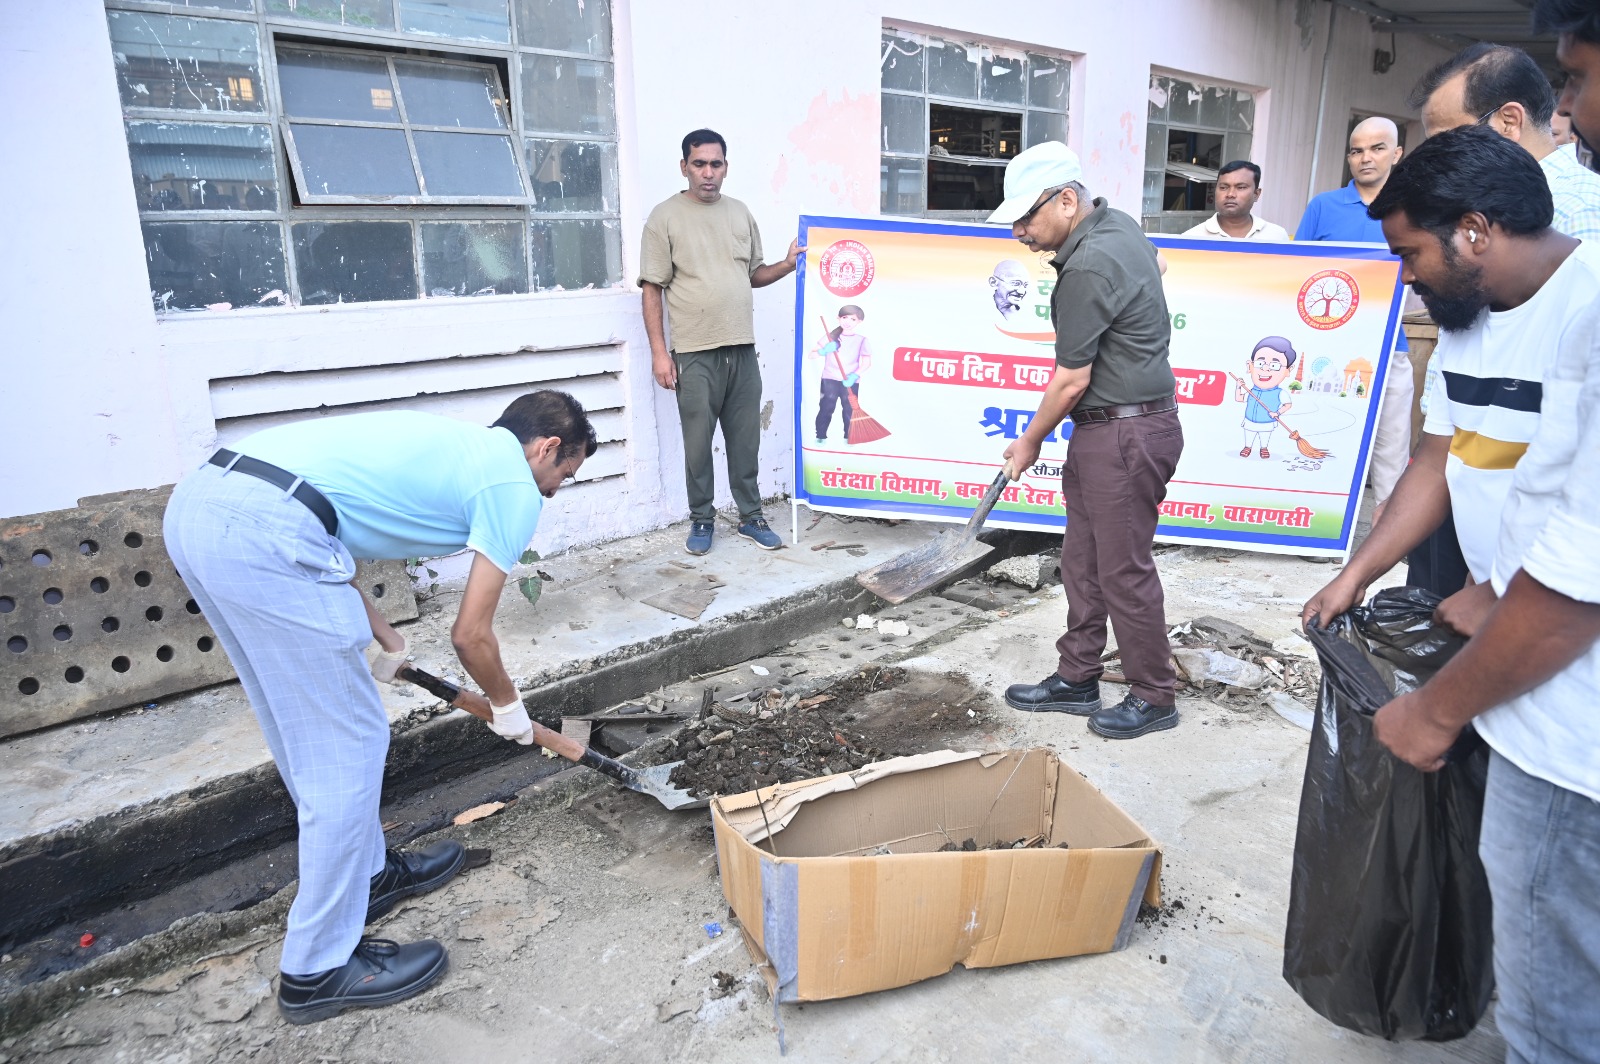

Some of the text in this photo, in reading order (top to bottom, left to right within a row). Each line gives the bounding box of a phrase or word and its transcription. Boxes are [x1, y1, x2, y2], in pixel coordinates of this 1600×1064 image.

[846, 241, 874, 287] INDIAN RAILWAYS
[962, 354, 1005, 386] दिन,
[1013, 364, 1053, 386] एक
[820, 467, 877, 490] संरक्षा
[880, 471, 947, 500] विभाग,
[954, 481, 1021, 502] बनस
[1022, 483, 1057, 506] रेल
[1223, 505, 1314, 528] वाराणसी
